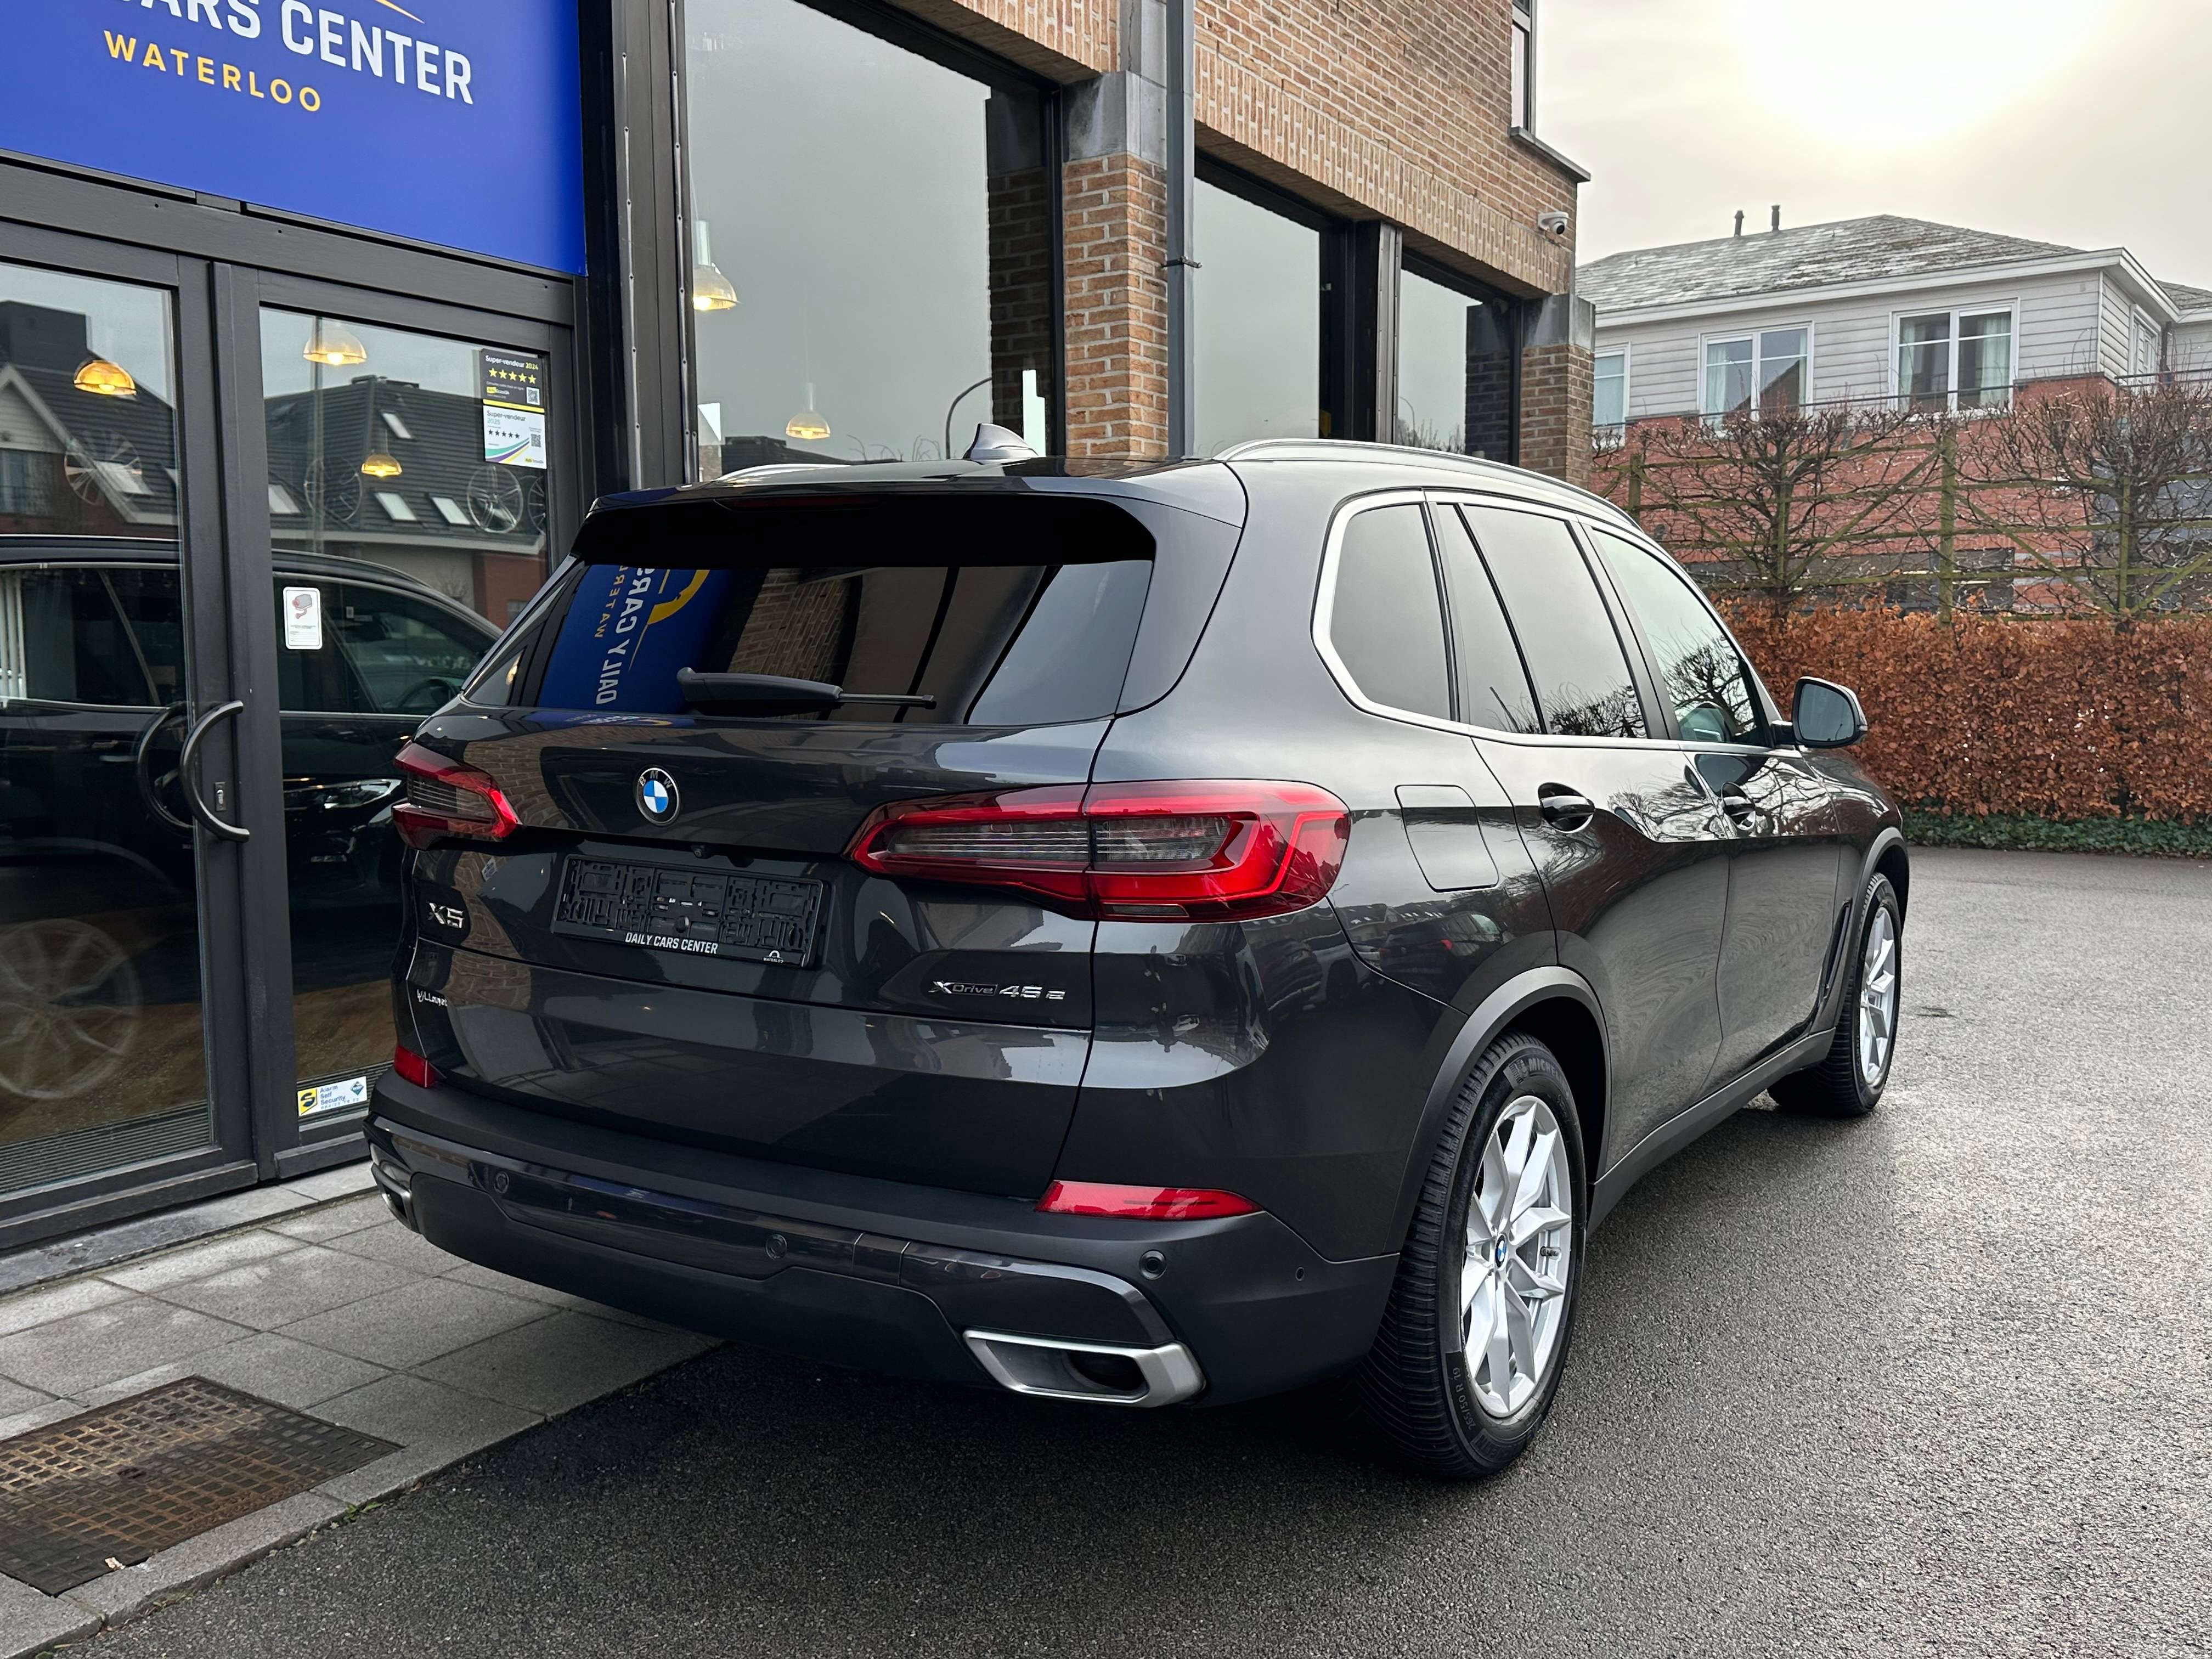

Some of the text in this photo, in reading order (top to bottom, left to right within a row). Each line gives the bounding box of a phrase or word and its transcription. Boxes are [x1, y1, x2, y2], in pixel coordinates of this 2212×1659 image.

[122, 0, 473, 105] RS CENTER
[103, 30, 321, 112] WATERLOO
[486, 355, 524, 368] Super-vendeur
[487, 410, 526, 421] Super-vendeur
[638, 770, 673, 789] BMW
[427, 902, 464, 929] X5
[625, 932, 718, 955] DAILY CARS CENTER
[320, 1085, 338, 1093] Alarm
[320, 1096, 346, 1105] Security
[1455, 1383, 1464, 1393] R
